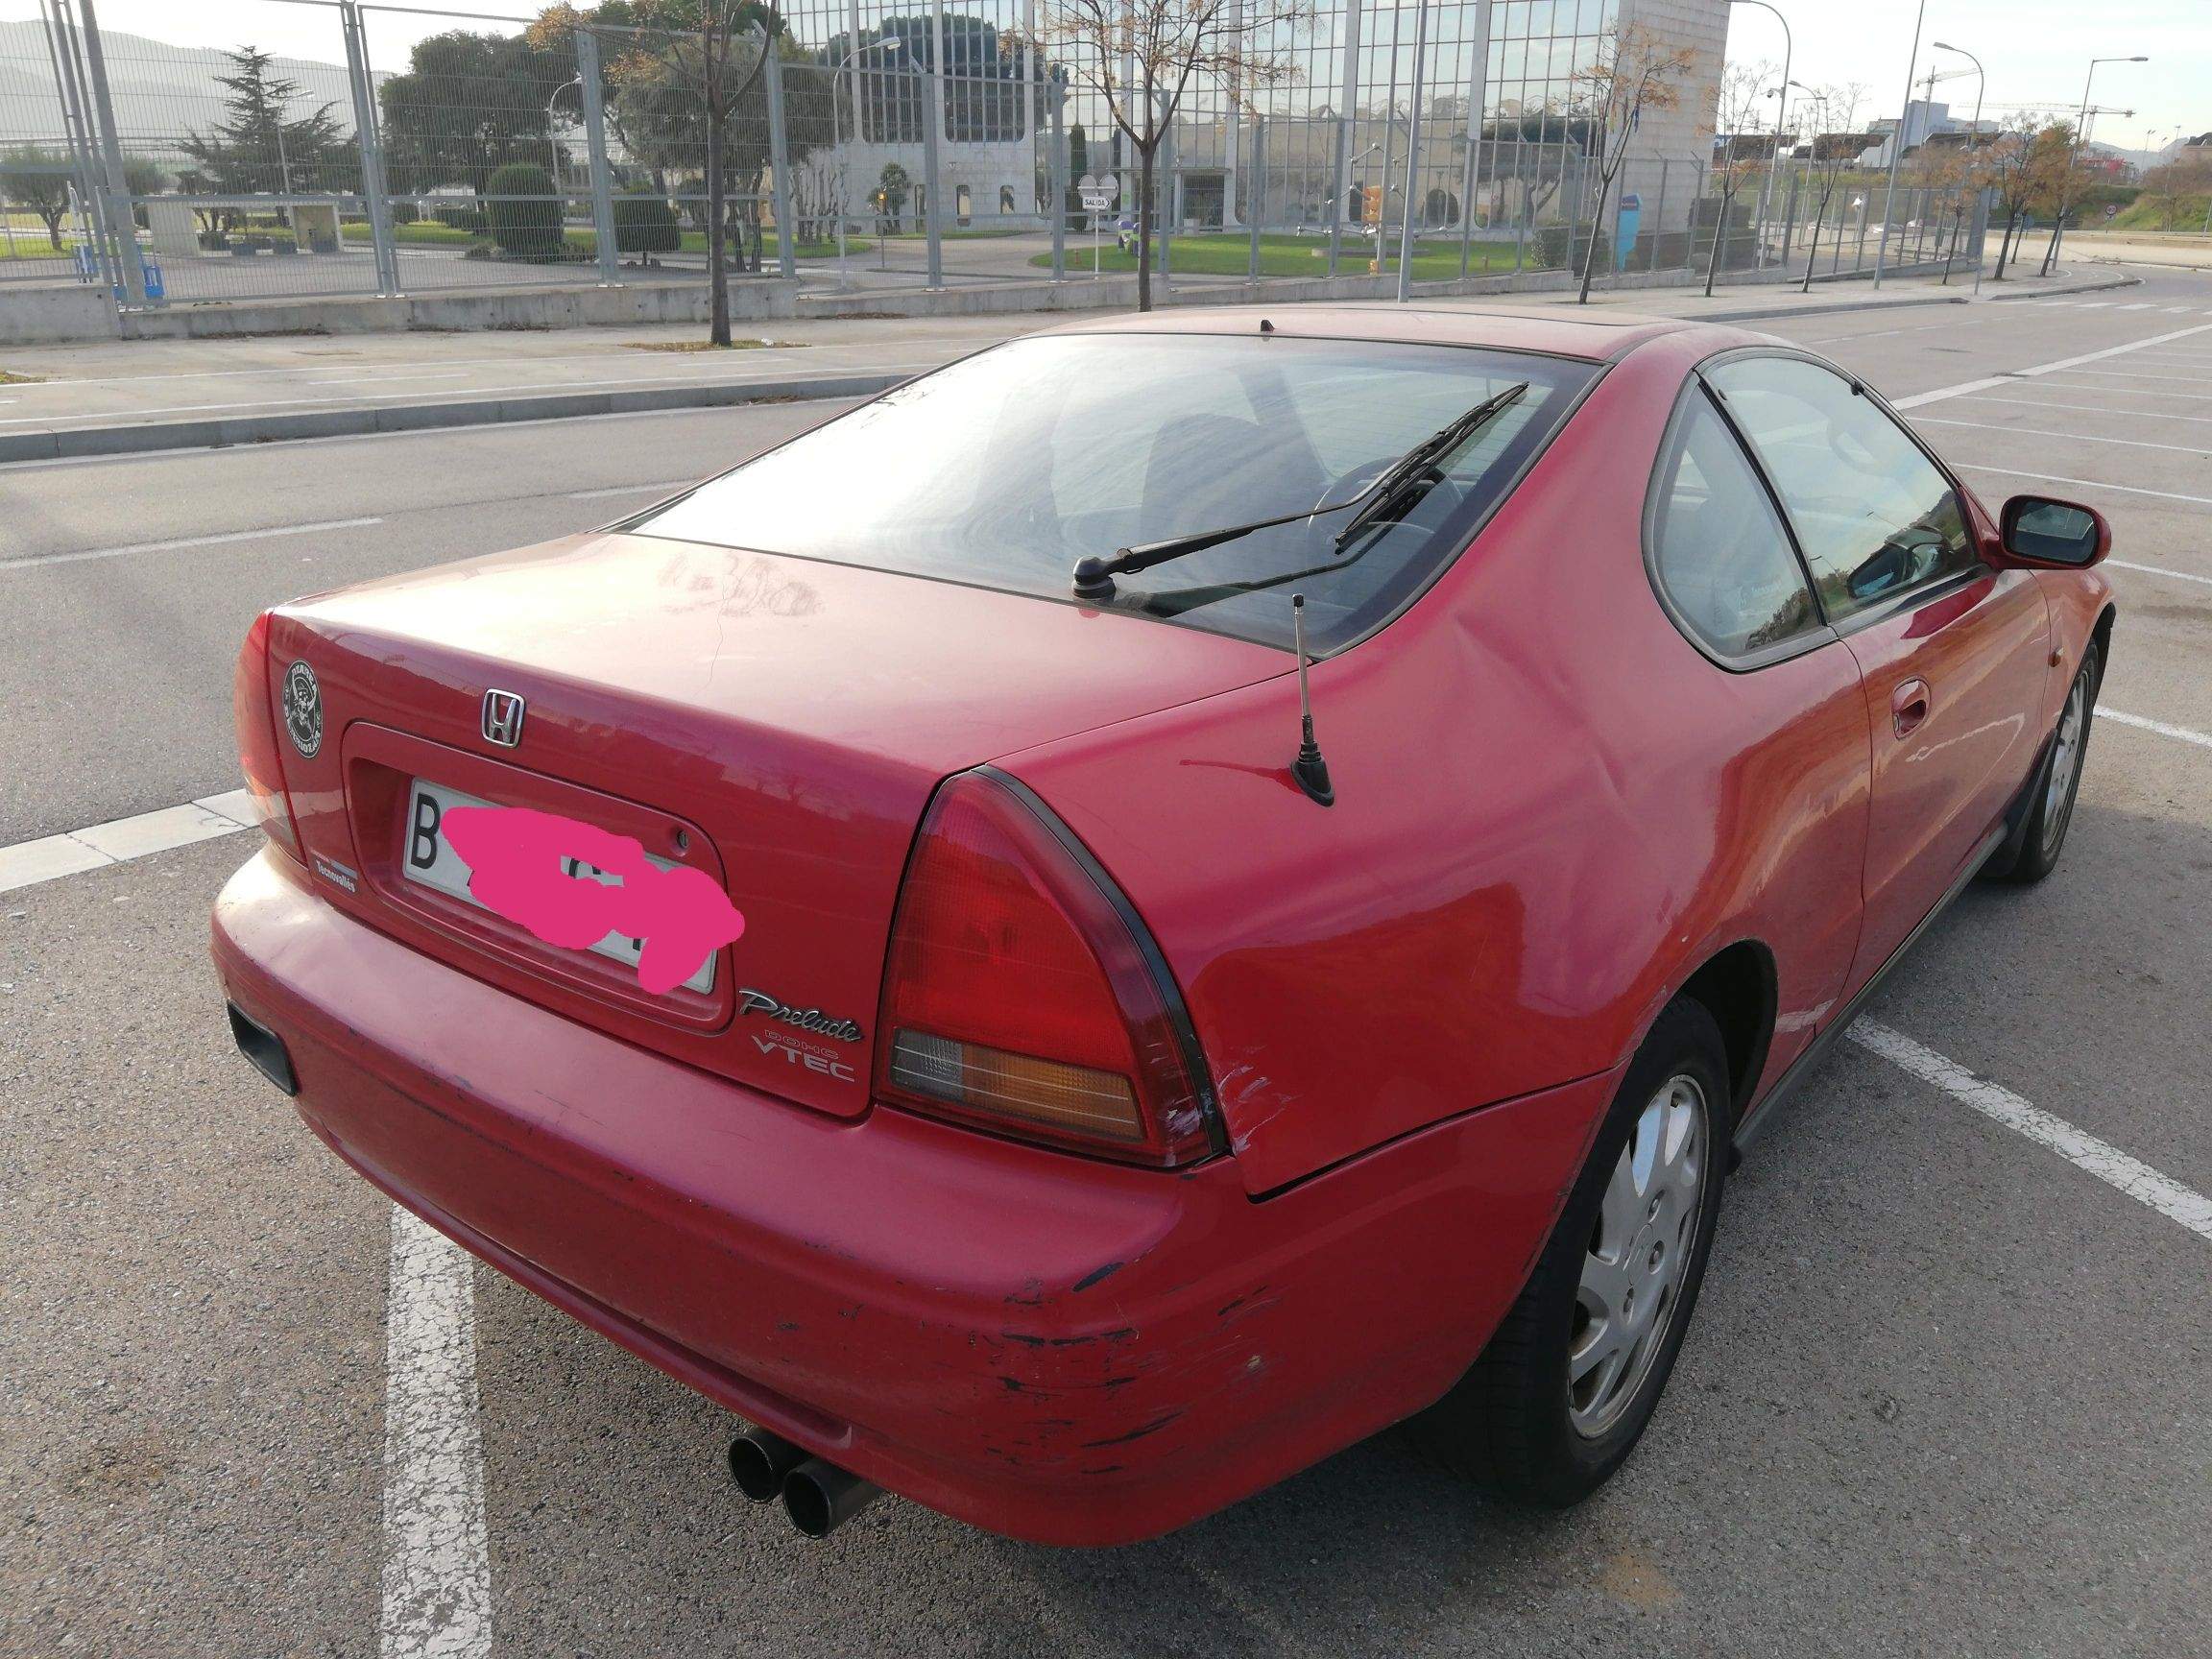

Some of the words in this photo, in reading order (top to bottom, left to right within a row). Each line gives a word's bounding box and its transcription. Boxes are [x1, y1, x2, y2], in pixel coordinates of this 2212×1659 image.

[1084, 199, 1106, 207] SALIDA
[738, 989, 863, 1042] Prelude
[751, 1035, 855, 1083] VTEC
[764, 1029, 840, 1060] DOHC
